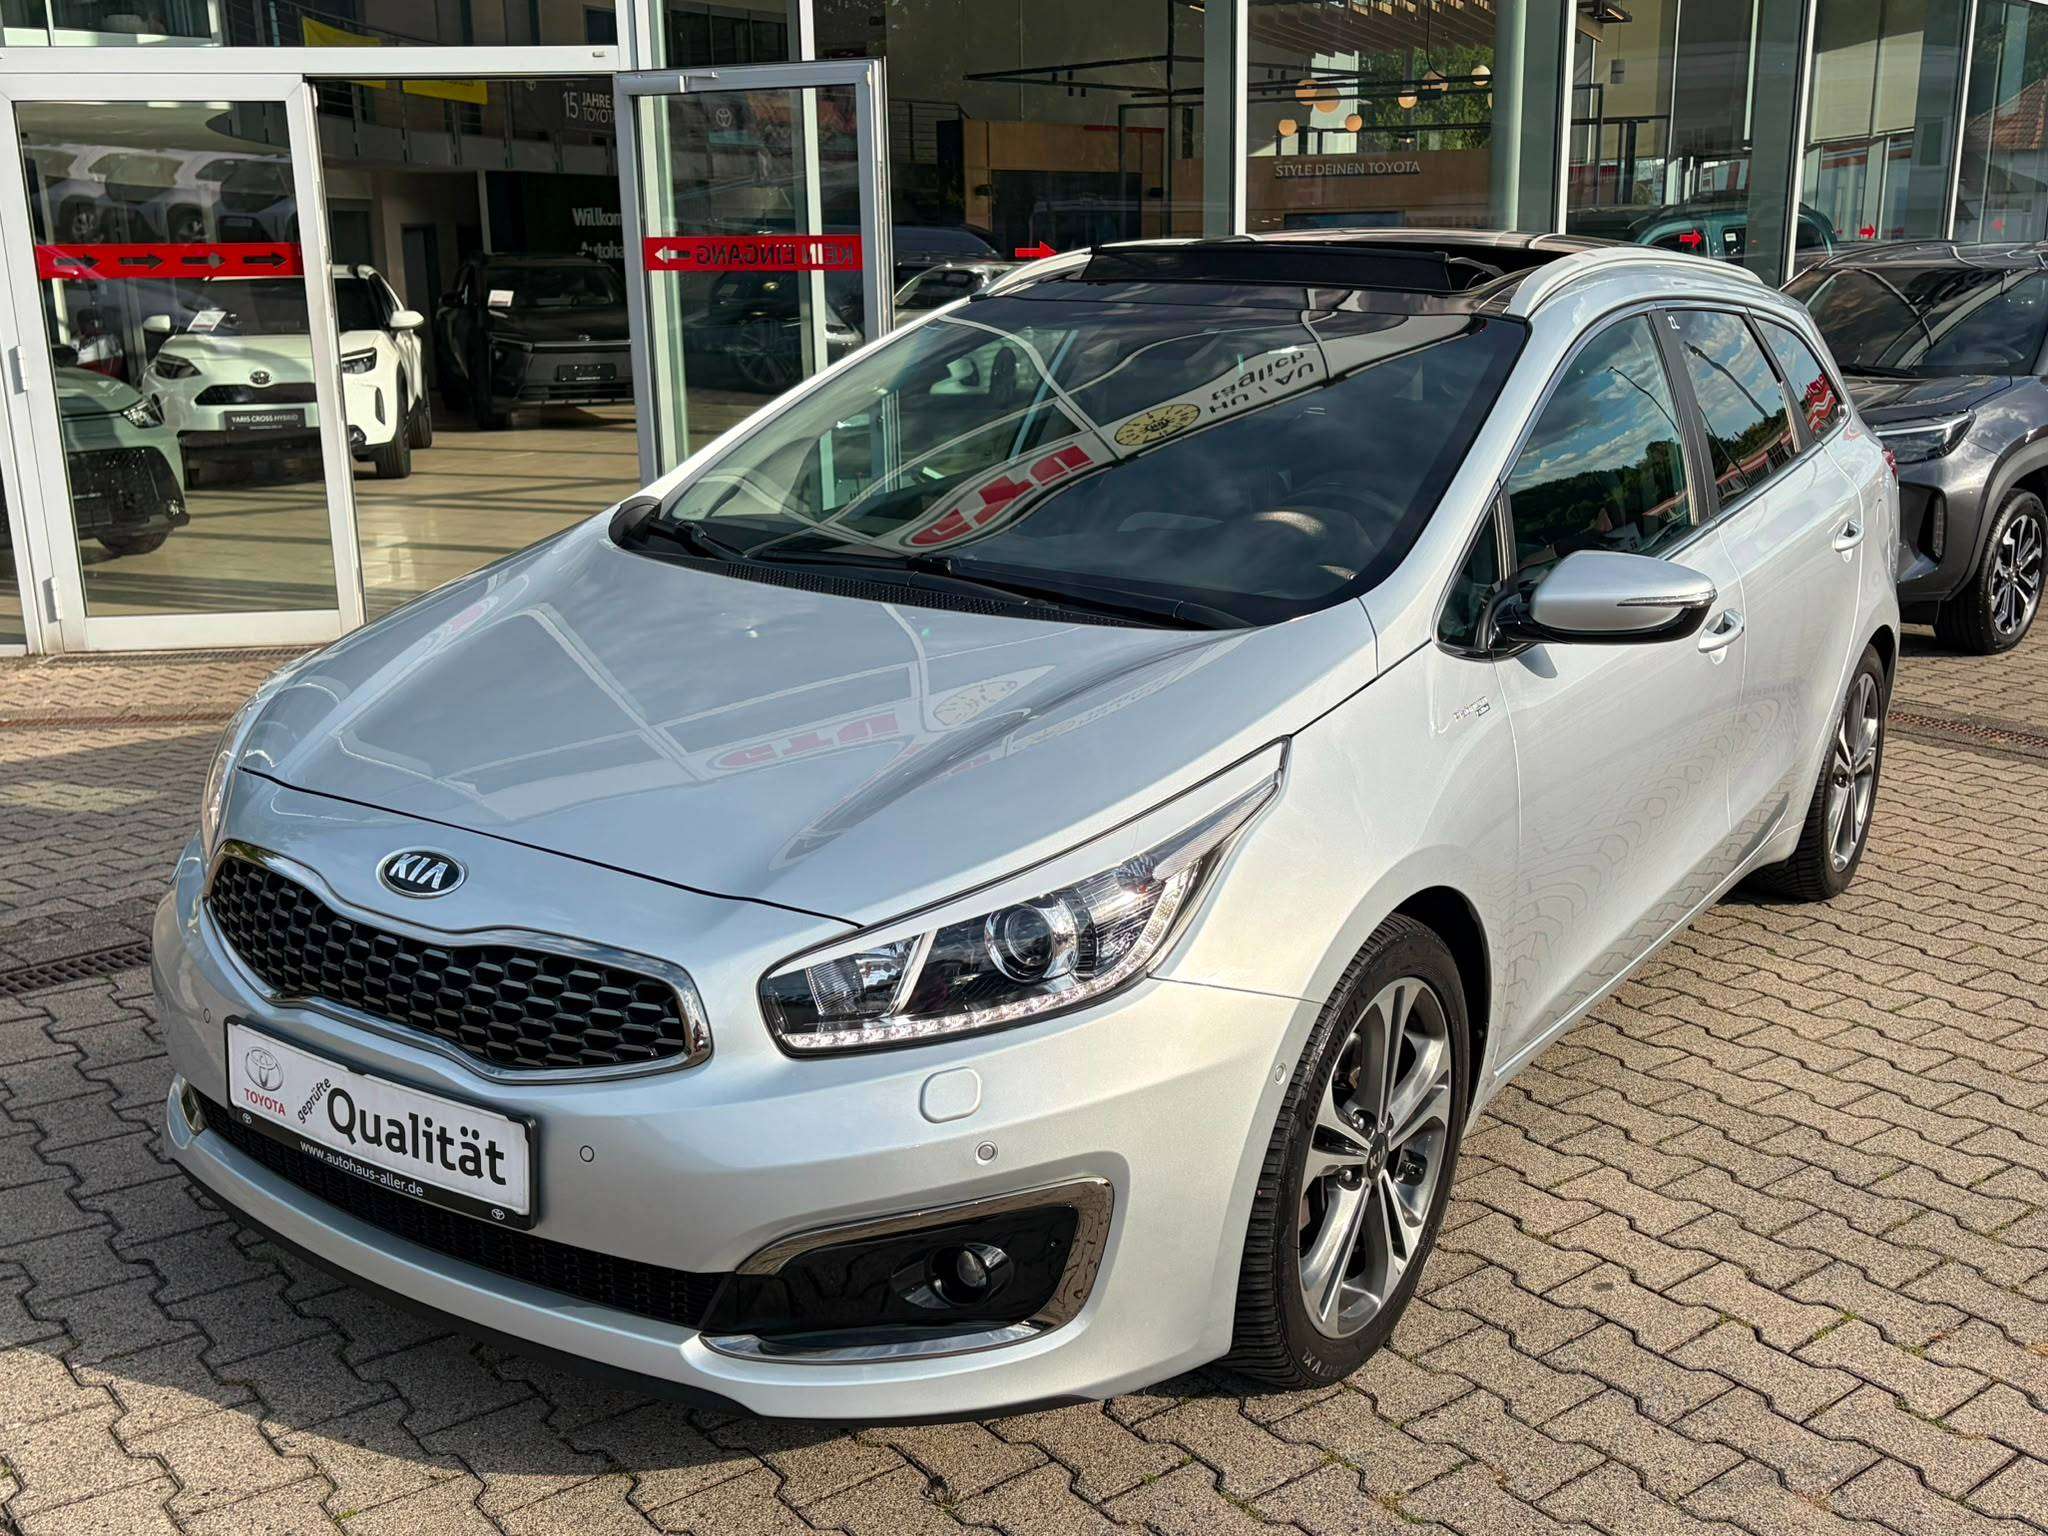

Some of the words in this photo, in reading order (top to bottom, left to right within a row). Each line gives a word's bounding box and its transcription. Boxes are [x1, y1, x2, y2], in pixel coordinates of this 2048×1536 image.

[563, 91, 579, 119] 15
[582, 91, 611, 109] JAHRE
[581, 107, 615, 123] TOYOT
[1275, 164, 1312, 177] STYLE
[1315, 162, 1365, 176] DEINEN
[1368, 160, 1421, 174] TOYOTA
[231, 415, 251, 423] YARIS
[251, 414, 273, 422] CROSS
[389, 853, 448, 889] KIA
[243, 1087, 286, 1116] TOYOTA
[297, 1077, 332, 1124] geprüfte
[327, 1087, 507, 1185] Qualität
[299, 1140, 424, 1197] www.autohaus-aller.de
[1370, 1145, 1389, 1169] KIA
